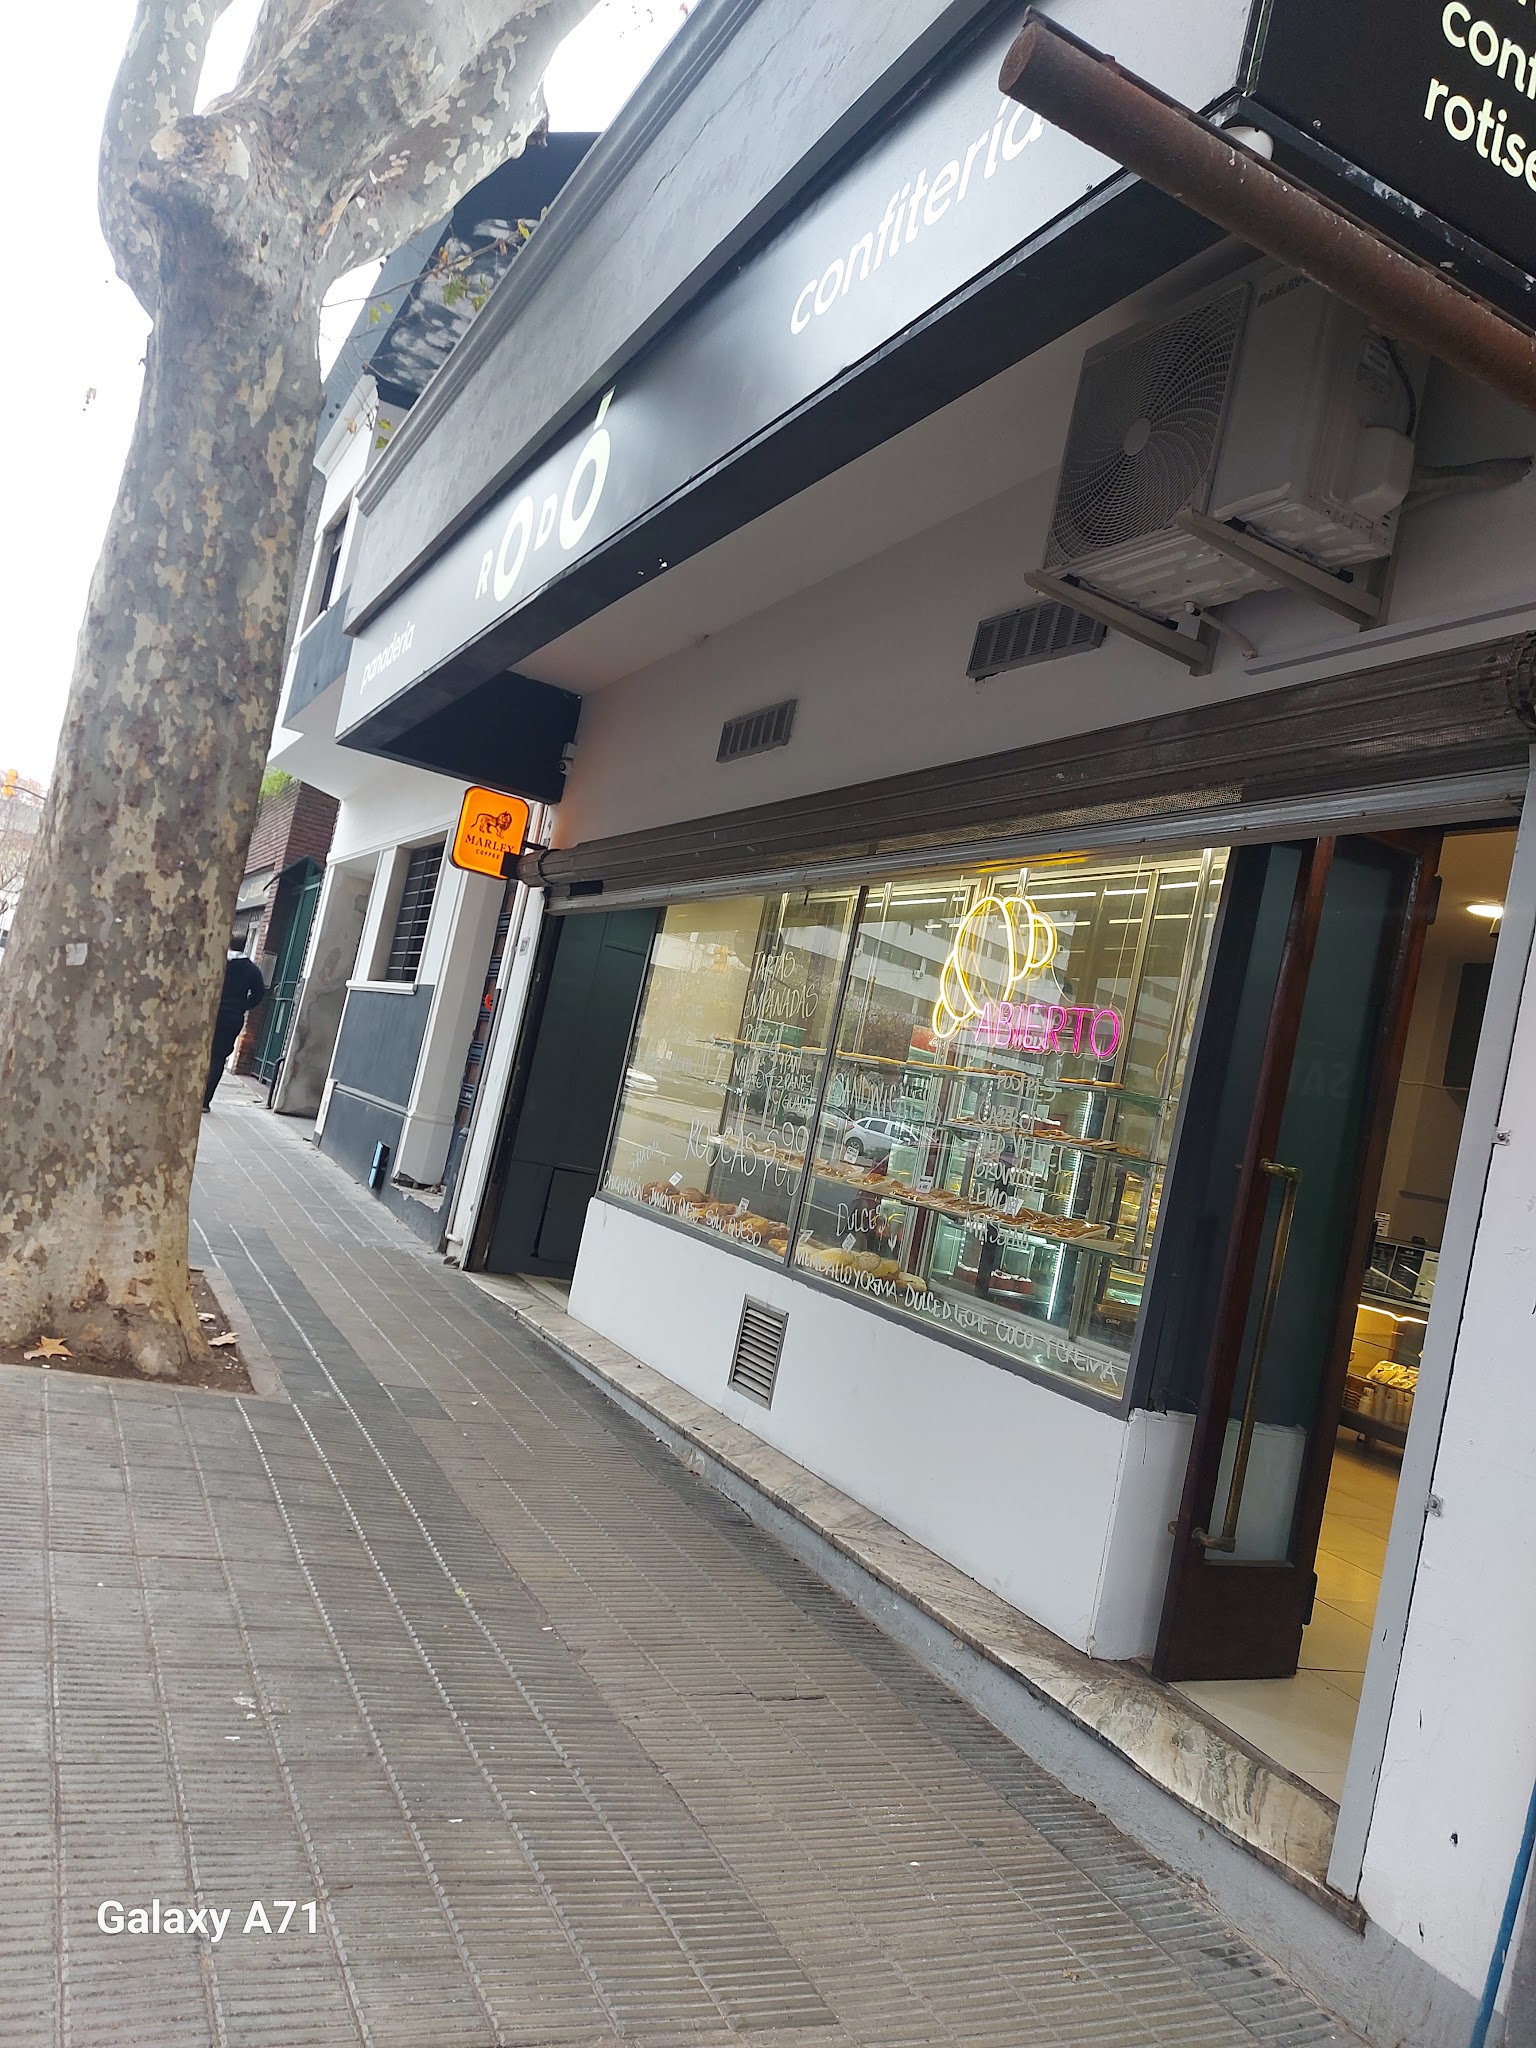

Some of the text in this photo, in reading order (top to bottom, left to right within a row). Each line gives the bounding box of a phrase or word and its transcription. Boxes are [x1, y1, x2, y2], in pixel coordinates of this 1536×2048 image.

[790, 97, 1044, 335] confitería
[475, 385, 616, 602] RODÓ
[360, 620, 415, 696] panadería
[465, 834, 515, 853] MARLEY
[475, 849, 500, 859] COFFEE
[753, 951, 796, 982] TARTAS
[743, 983, 819, 1020] EMPANADAS
[975, 1001, 1119, 1057] ABIERTO
[996, 1072, 1057, 1102] POSTRES
[684, 1116, 757, 1176] ROSCAS
[836, 1202, 887, 1237] DULCES
[996, 1319, 1035, 1349] COCO
[1056, 1340, 1118, 1387] CREMA
